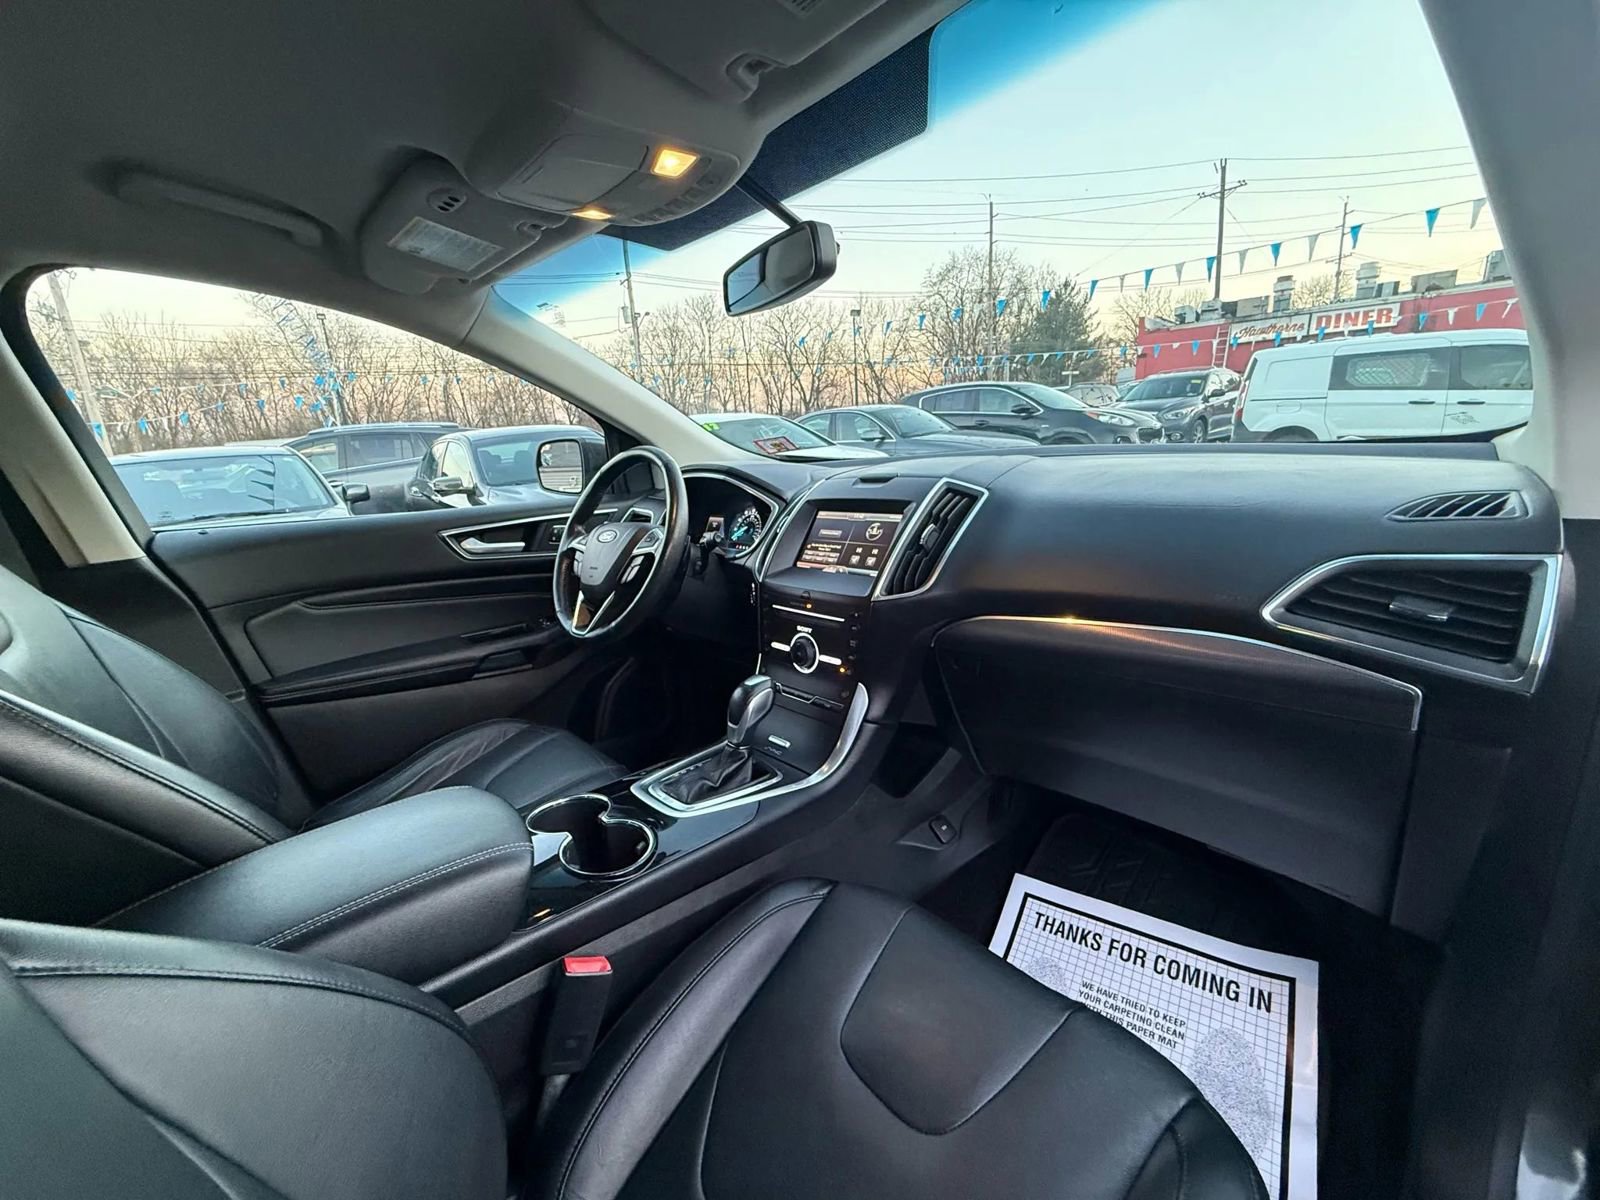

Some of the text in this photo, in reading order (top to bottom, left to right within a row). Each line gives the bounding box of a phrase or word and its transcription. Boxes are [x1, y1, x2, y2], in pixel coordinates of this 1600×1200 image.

[1315, 307, 1393, 330] DINER
[1034, 911, 1272, 1013] THANKS FOR COMING IN
[1079, 990, 1185, 1041] YOUR CARPETING CLEAN
[1082, 980, 1186, 1028] WE HAVE TRIED TO KEEP
[1126, 1020, 1155, 1040] PAPER
[1158, 1034, 1178, 1050] MAT
